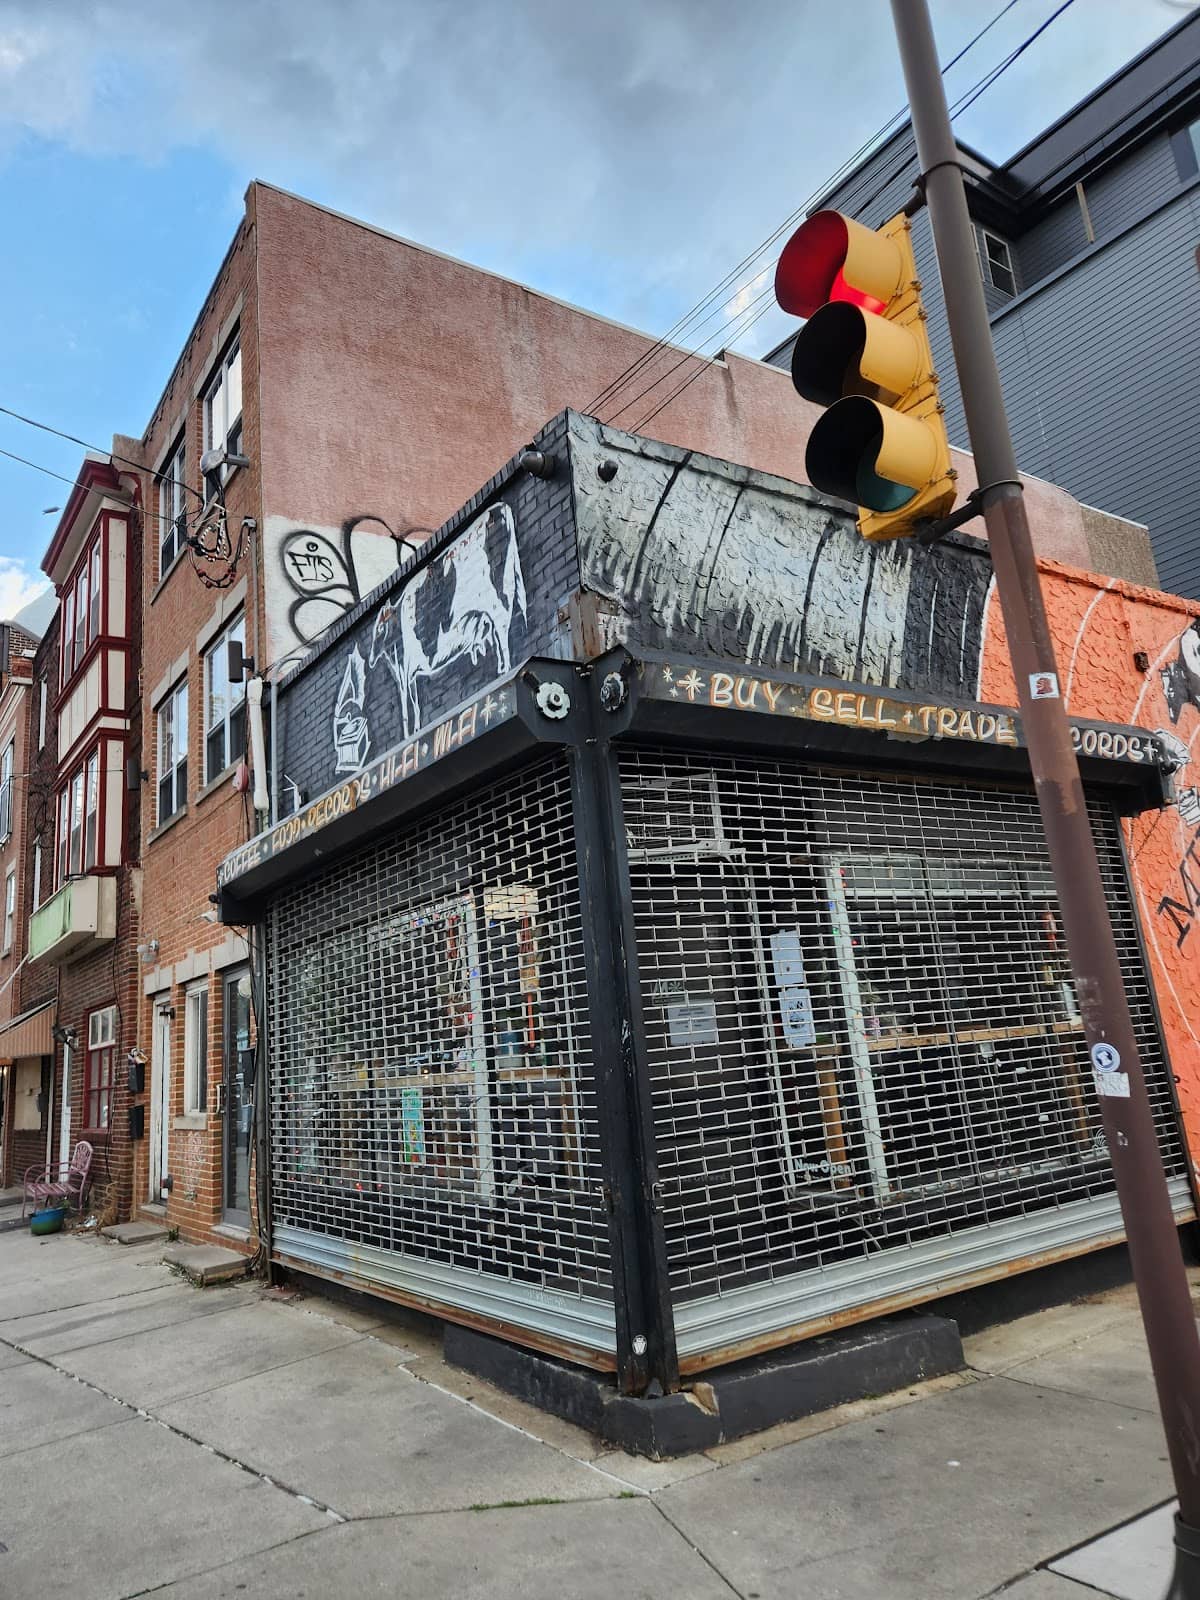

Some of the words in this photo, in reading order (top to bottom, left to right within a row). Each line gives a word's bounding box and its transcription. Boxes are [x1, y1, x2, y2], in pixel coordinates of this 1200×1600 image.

[710, 672, 788, 712] BUY
[809, 687, 897, 726] SELL
[917, 705, 1019, 748] TRADE
[1069, 726, 1145, 762] CORDS
[223, 840, 262, 881] COFFEE
[272, 816, 301, 856] FOOD
[308, 771, 371, 827] RECORDS
[379, 739, 419, 790] HI-FI
[433, 702, 478, 759] WI-FI
[819, 1159, 852, 1175] Open
